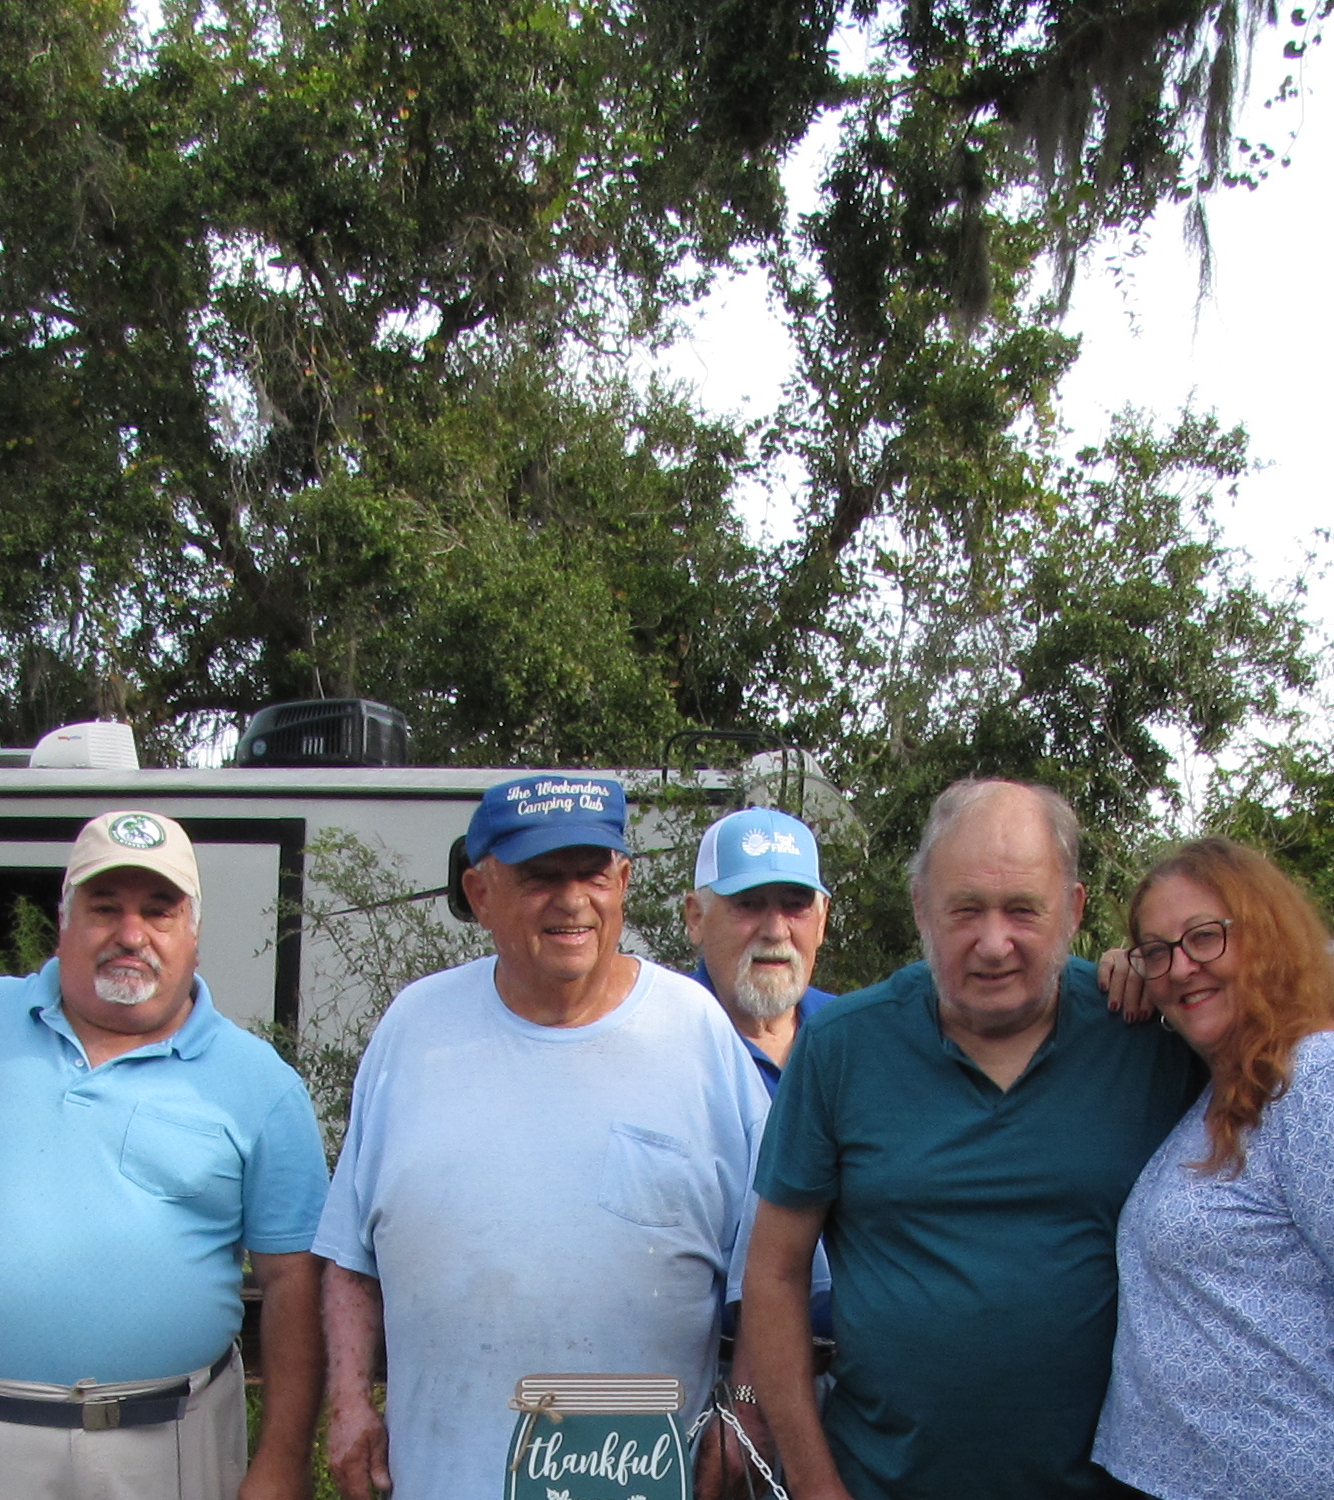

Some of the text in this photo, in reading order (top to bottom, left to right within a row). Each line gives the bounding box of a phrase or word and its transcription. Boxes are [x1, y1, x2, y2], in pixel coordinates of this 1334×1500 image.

[507, 780, 610, 801] The Weekenders
[518, 794, 604, 815] Camping Club
[526, 1431, 673, 1486] thankful
